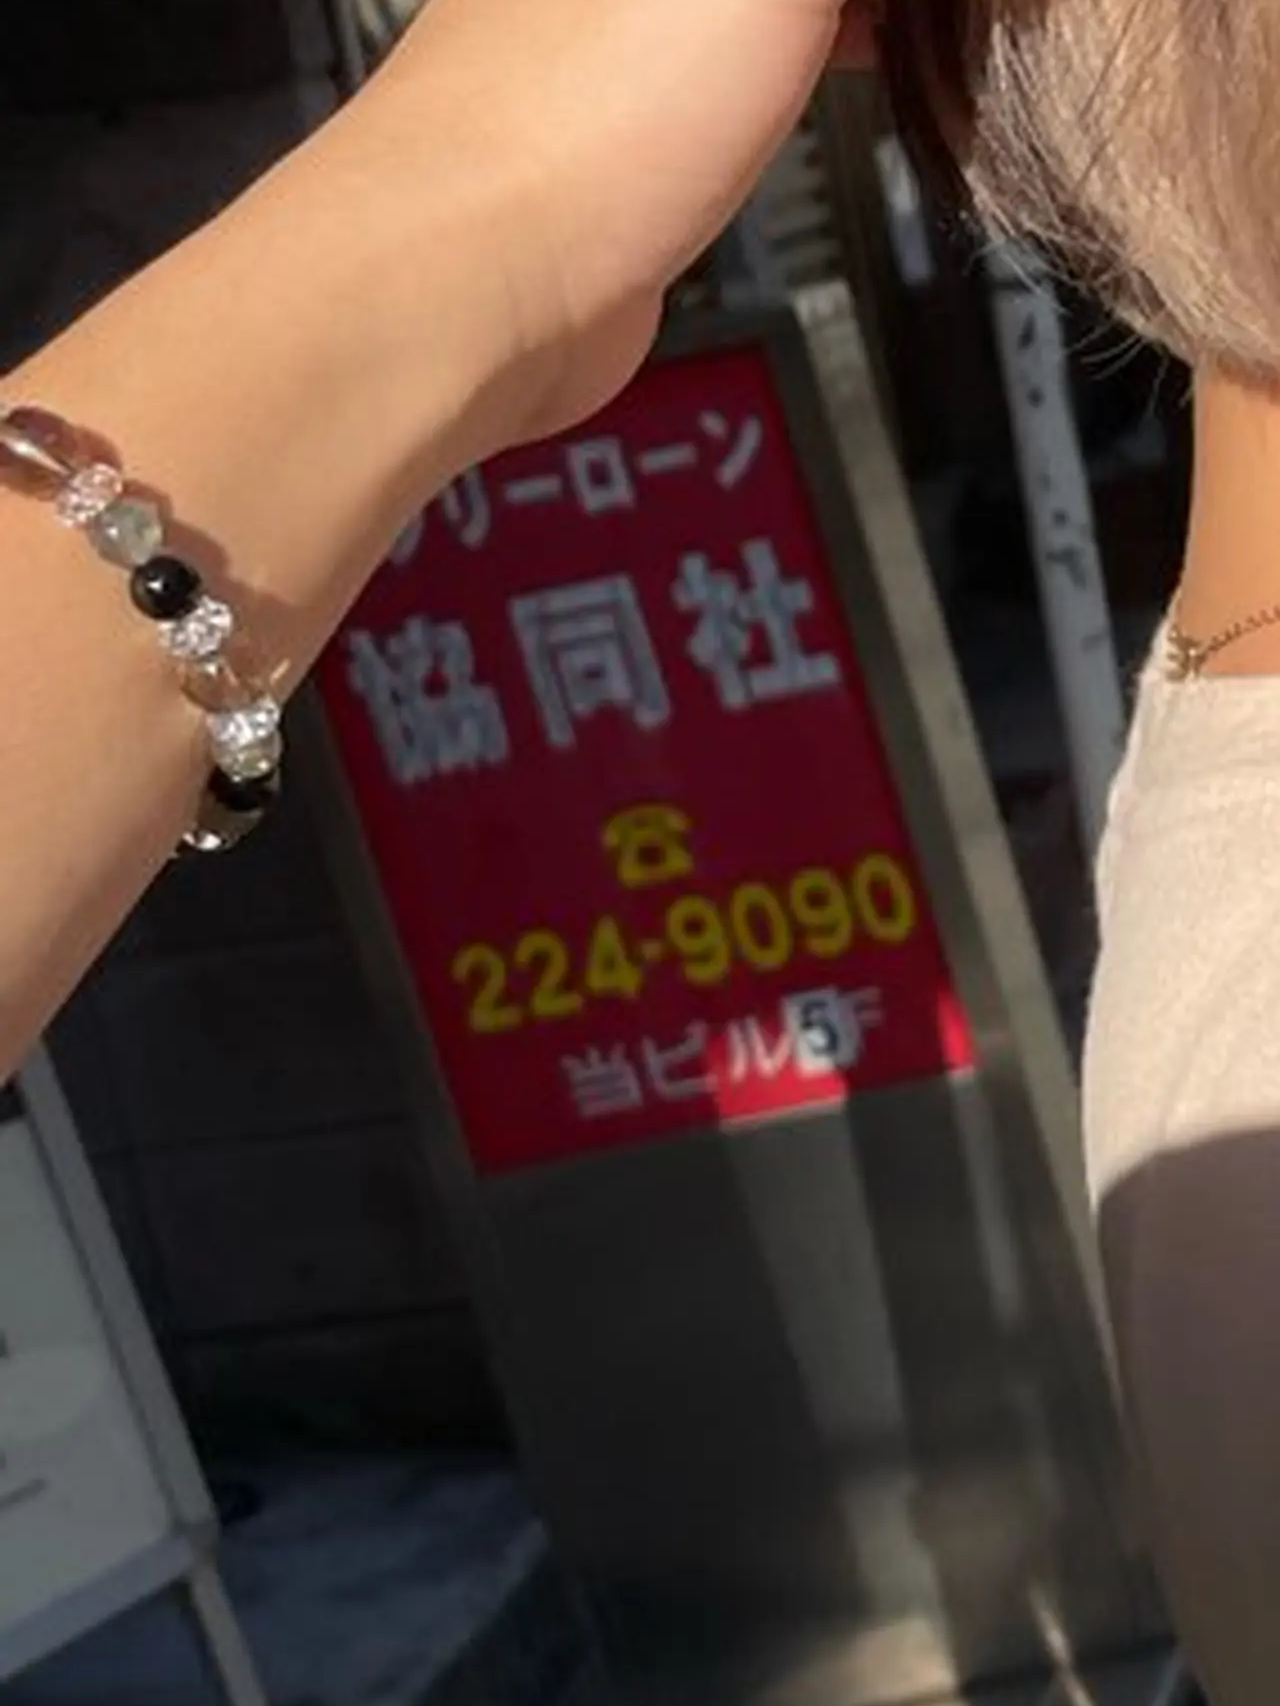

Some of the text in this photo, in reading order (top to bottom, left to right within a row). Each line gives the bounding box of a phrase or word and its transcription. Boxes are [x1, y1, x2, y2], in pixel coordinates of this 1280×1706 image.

[390, 410, 763, 566] リーローン
[348, 538, 841, 784] 協同社
